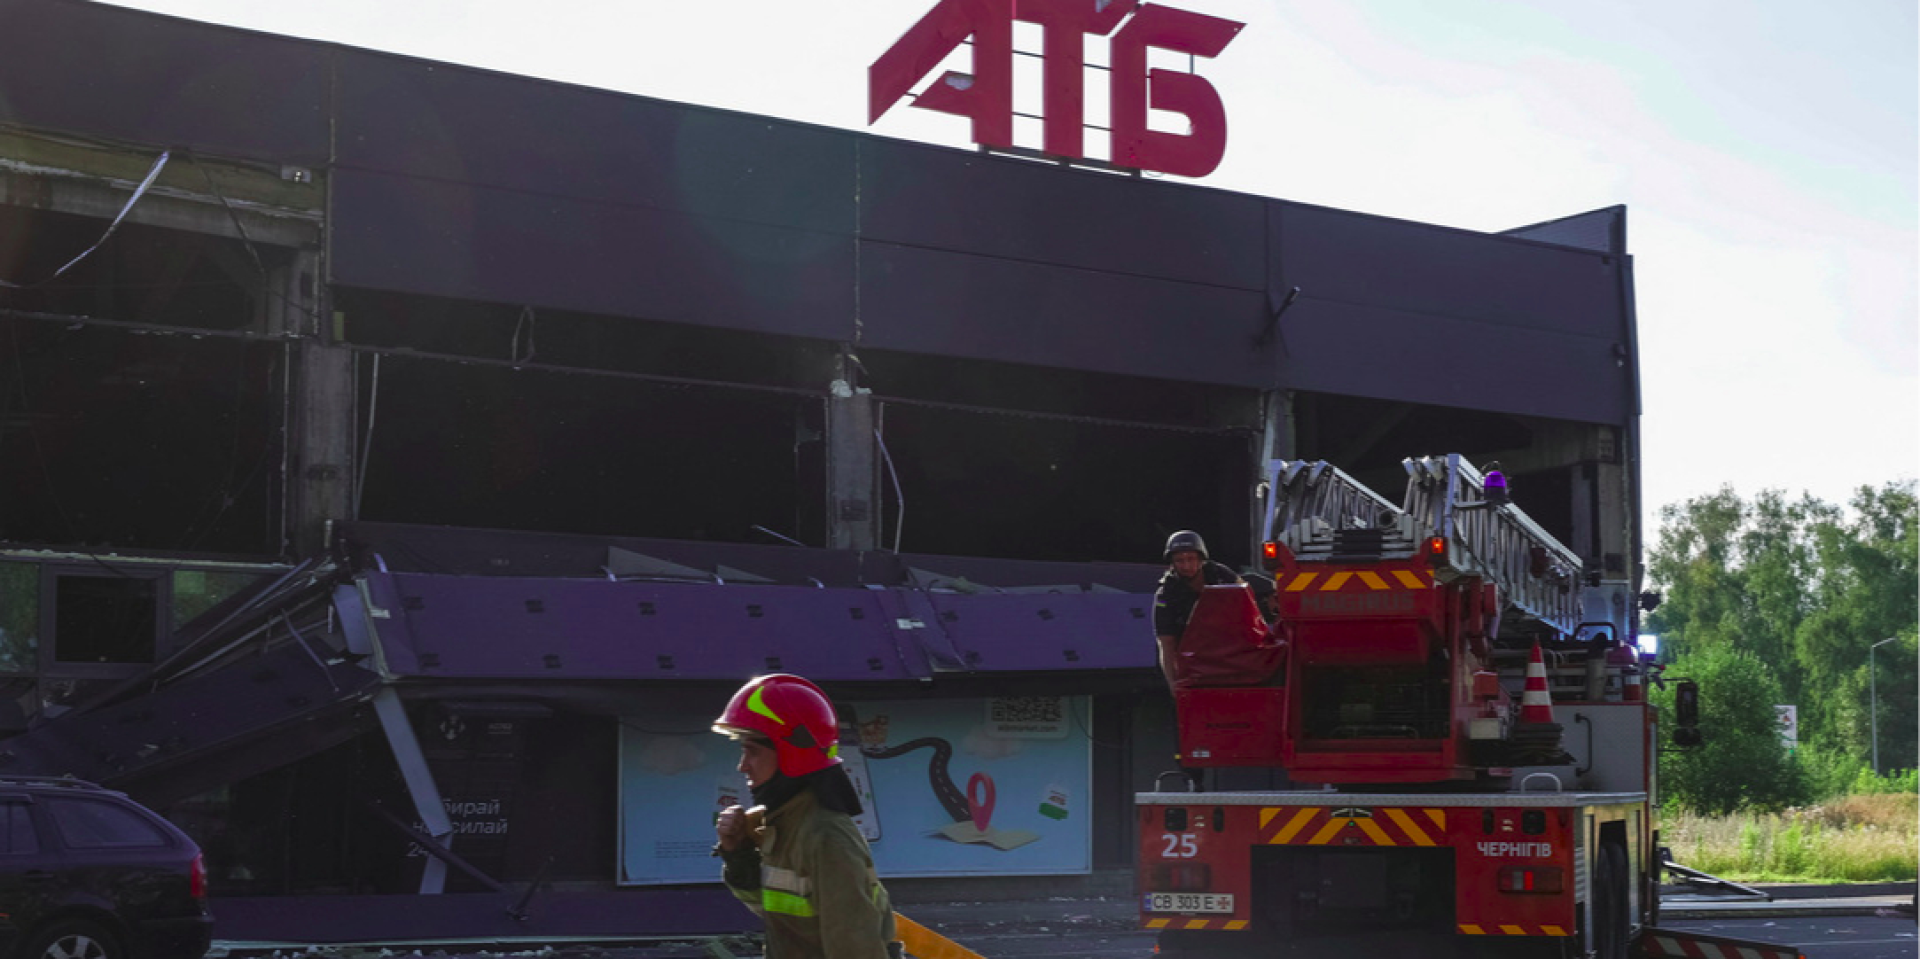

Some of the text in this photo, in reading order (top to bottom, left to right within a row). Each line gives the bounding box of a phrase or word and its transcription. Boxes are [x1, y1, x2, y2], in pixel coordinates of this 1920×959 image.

[867, 0, 1247, 178] АТБ
[1301, 592, 1414, 611] MAGIRUS
[1161, 834, 1198, 858] 25
[1477, 842, 1552, 857] ЧЕРНІГІВ
[1177, 895, 1200, 909] 303
